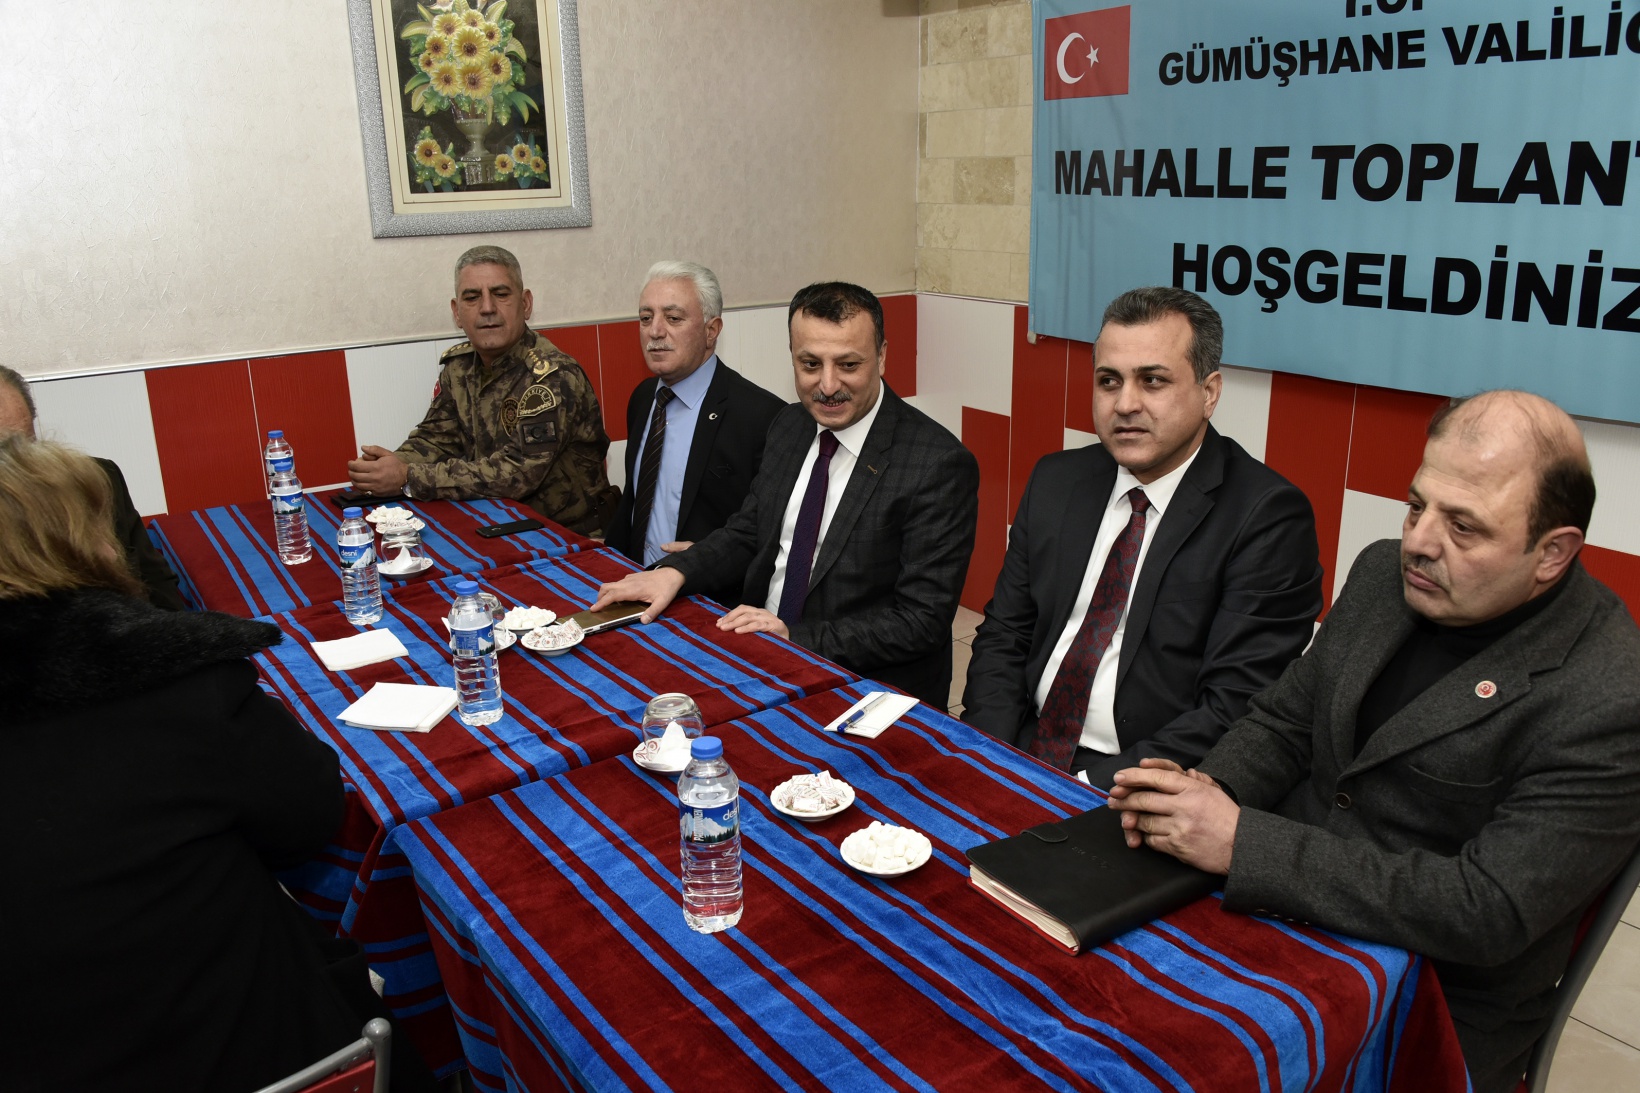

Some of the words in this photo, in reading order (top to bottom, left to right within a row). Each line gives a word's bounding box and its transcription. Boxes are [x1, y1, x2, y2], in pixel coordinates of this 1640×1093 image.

[1158, 29, 1426, 87] GÜMÜŞHANE
[1055, 146, 1290, 200] MAHALLE
[1311, 140, 1640, 207] TOPLAN
[1172, 242, 1640, 334] HOŞGELDİNİZ
